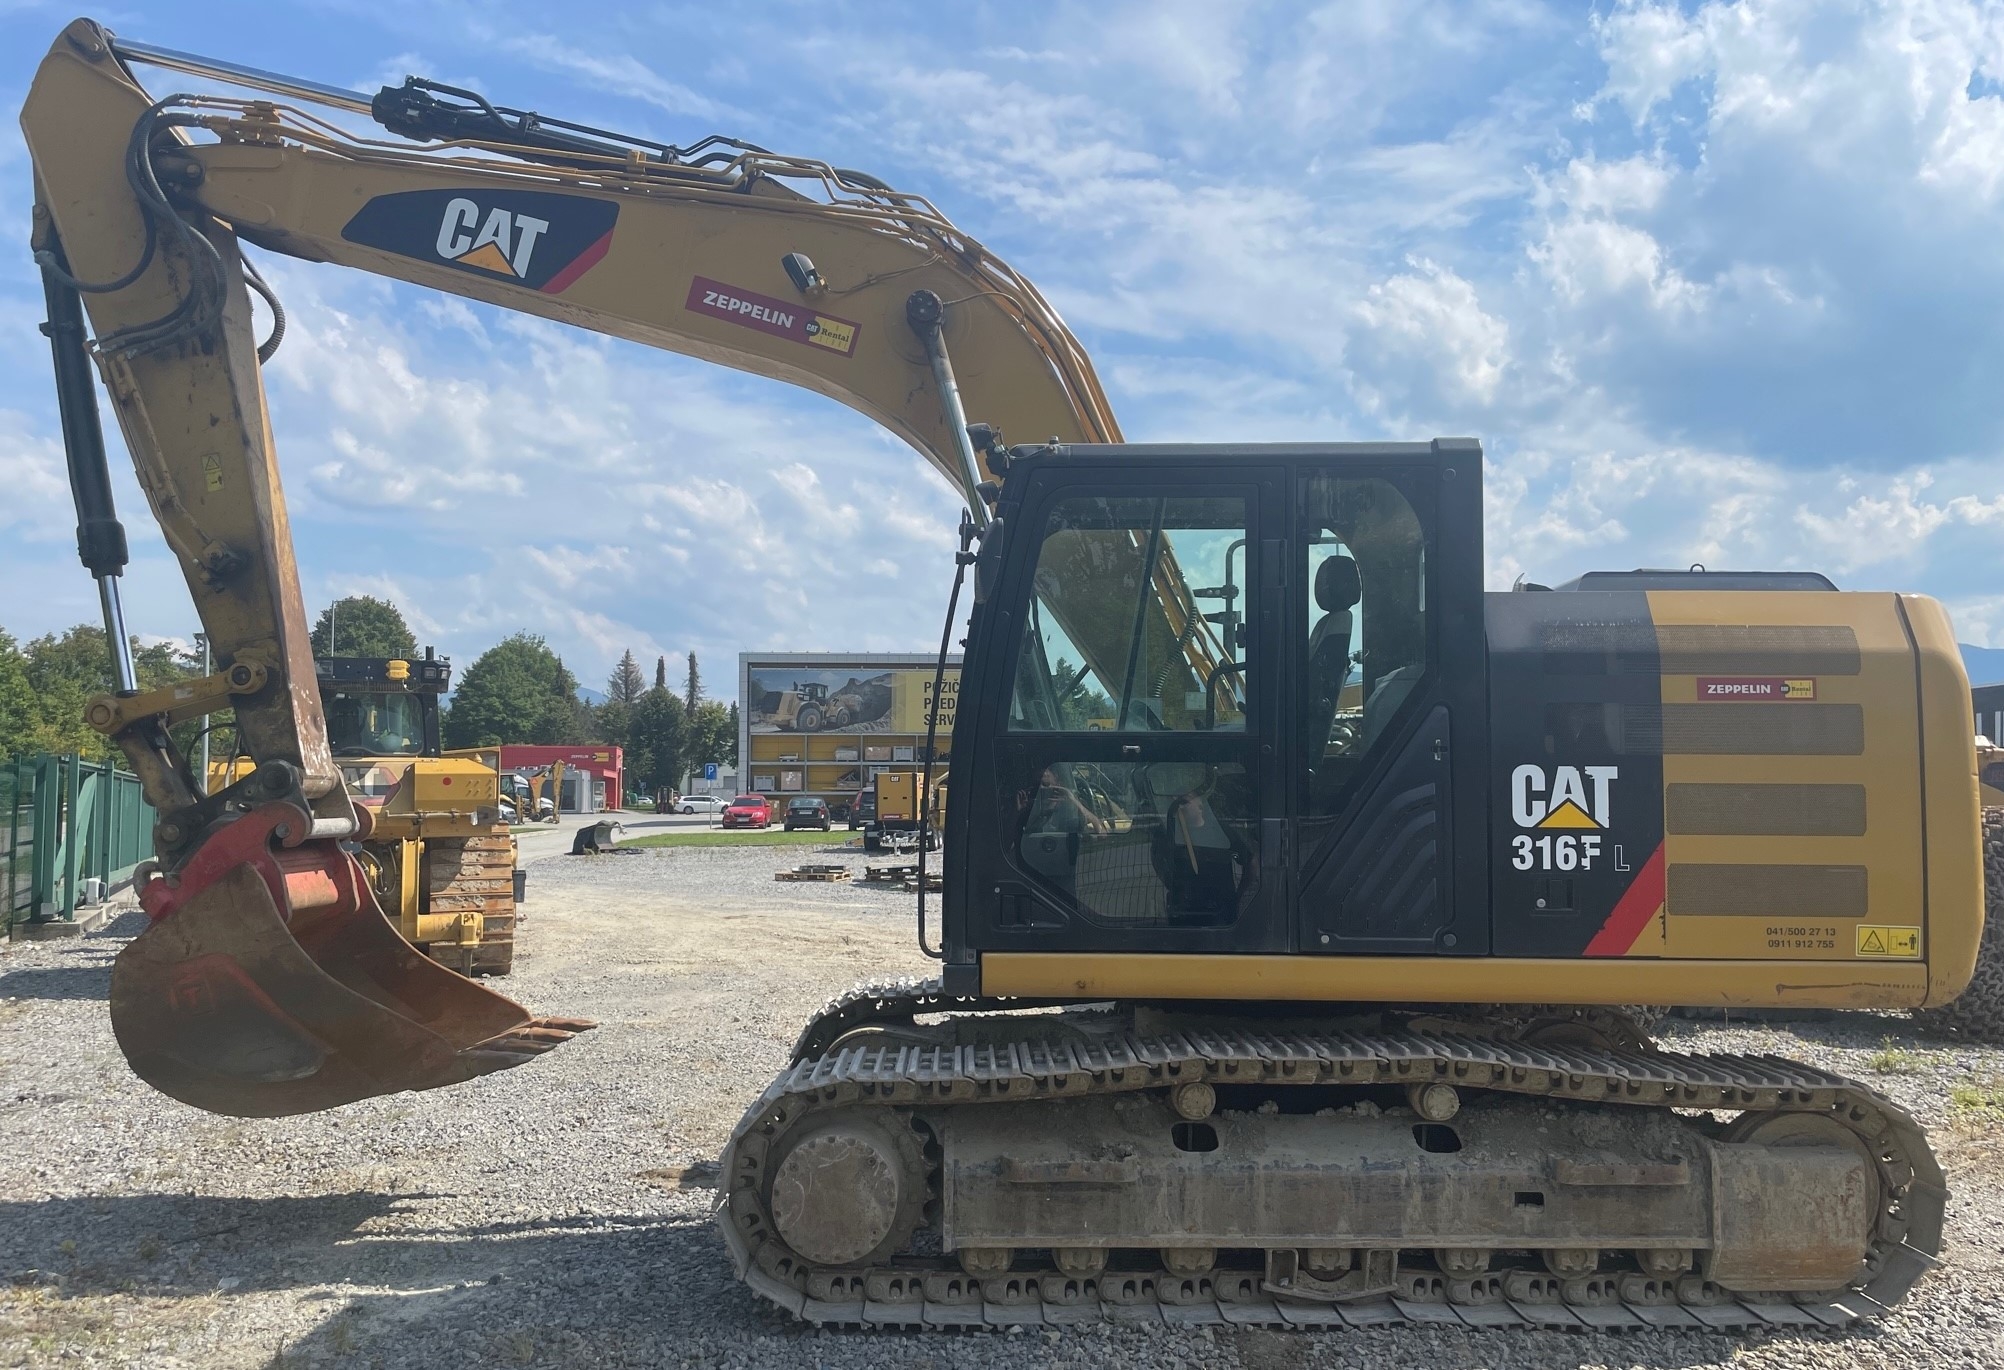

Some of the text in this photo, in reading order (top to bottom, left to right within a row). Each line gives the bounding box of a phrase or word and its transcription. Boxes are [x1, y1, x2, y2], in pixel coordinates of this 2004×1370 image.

[436, 197, 550, 279] CAT
[703, 290, 793, 328] ZEPPELIN
[806, 323, 819, 333] CAT
[821, 327, 850, 343] Rental
[923, 678, 960, 694] PŽIČ
[1707, 684, 1771, 694] ZEPPELIN
[923, 697, 956, 710] PED
[708, 765, 714, 775] P
[1511, 764, 1618, 829] CAT
[1511, 835, 1631, 872] 316F L
[1766, 927, 1836, 936] 041/500 27 13
[1768, 939, 1834, 948] 0911 912 755
